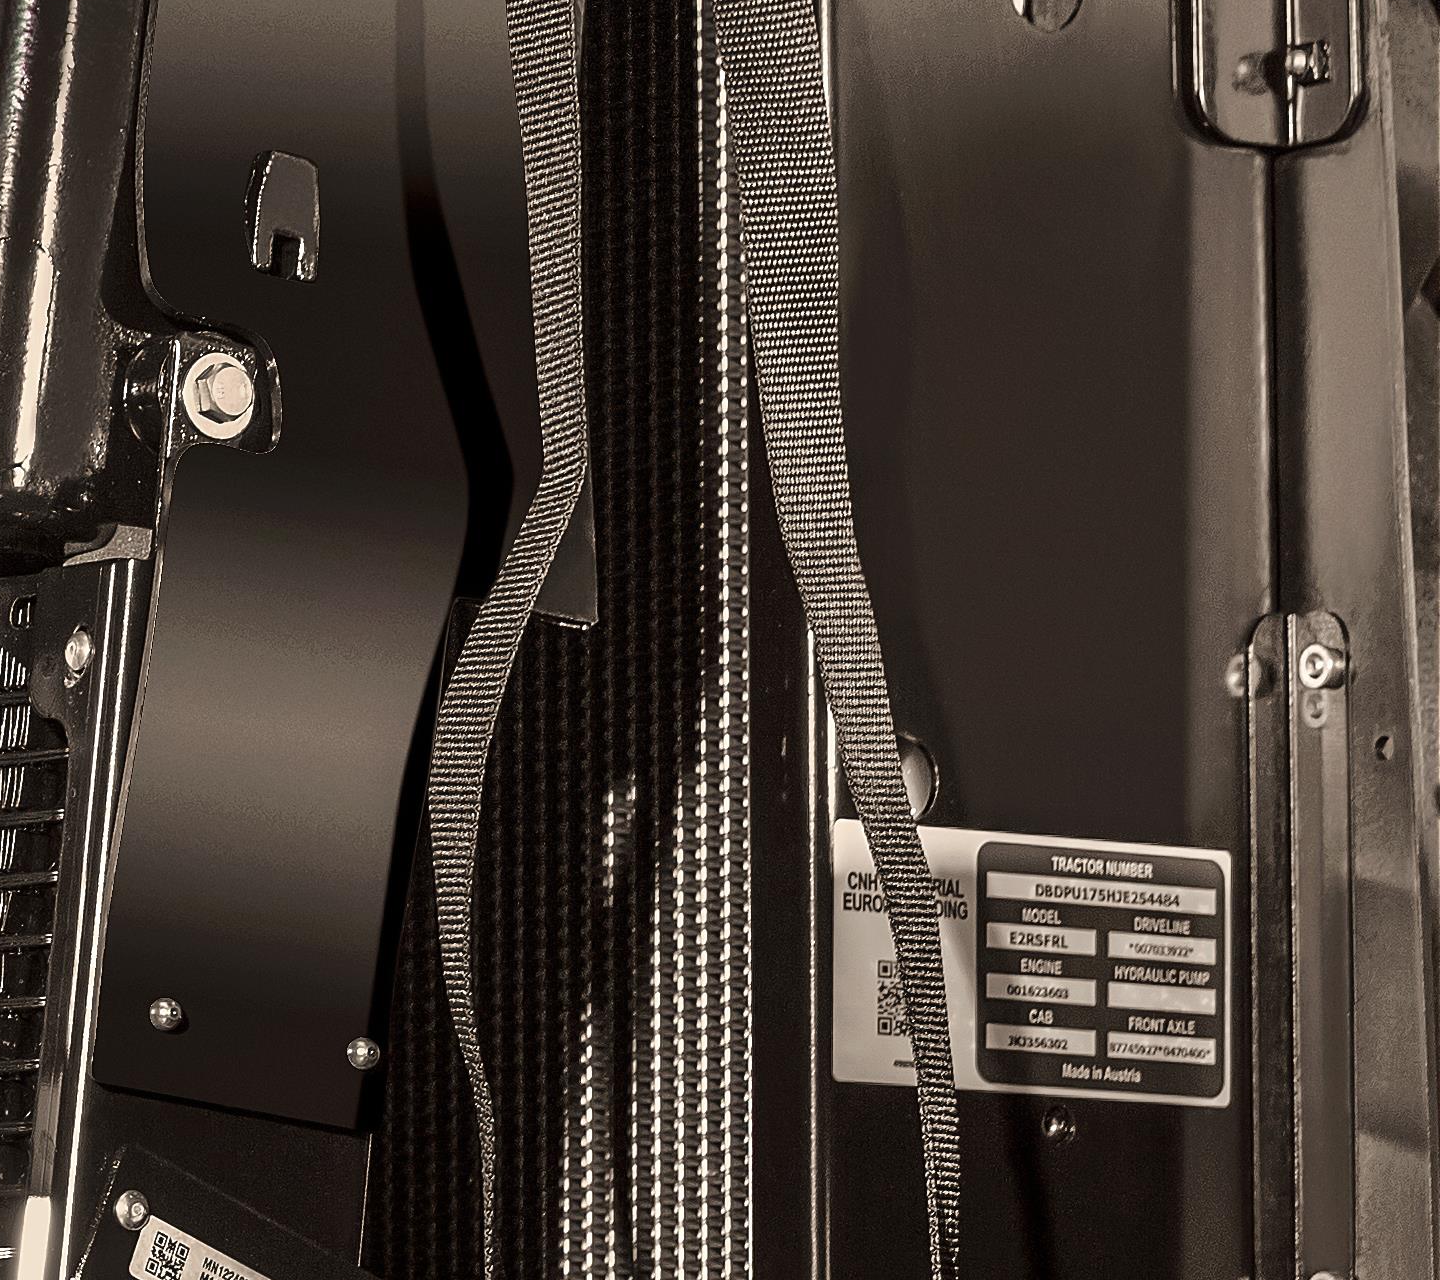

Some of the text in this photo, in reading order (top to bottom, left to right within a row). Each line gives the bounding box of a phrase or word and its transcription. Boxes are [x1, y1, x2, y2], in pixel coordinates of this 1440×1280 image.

[1051, 855, 1154, 879] TRACTOR NUMBER
[847, 871, 879, 891] CNH
[1021, 907, 1062, 925] MODEL
[1133, 916, 1191, 936] DRIVELINE
[1020, 957, 1063, 976] ENGINE
[1114, 965, 1211, 986] HYDRAULIC PUMP
[1028, 1008, 1054, 1025] CAB
[1128, 1015, 1196, 1035] FRONT AXLE
[1061, 1062, 1143, 1083] Made in Austria
